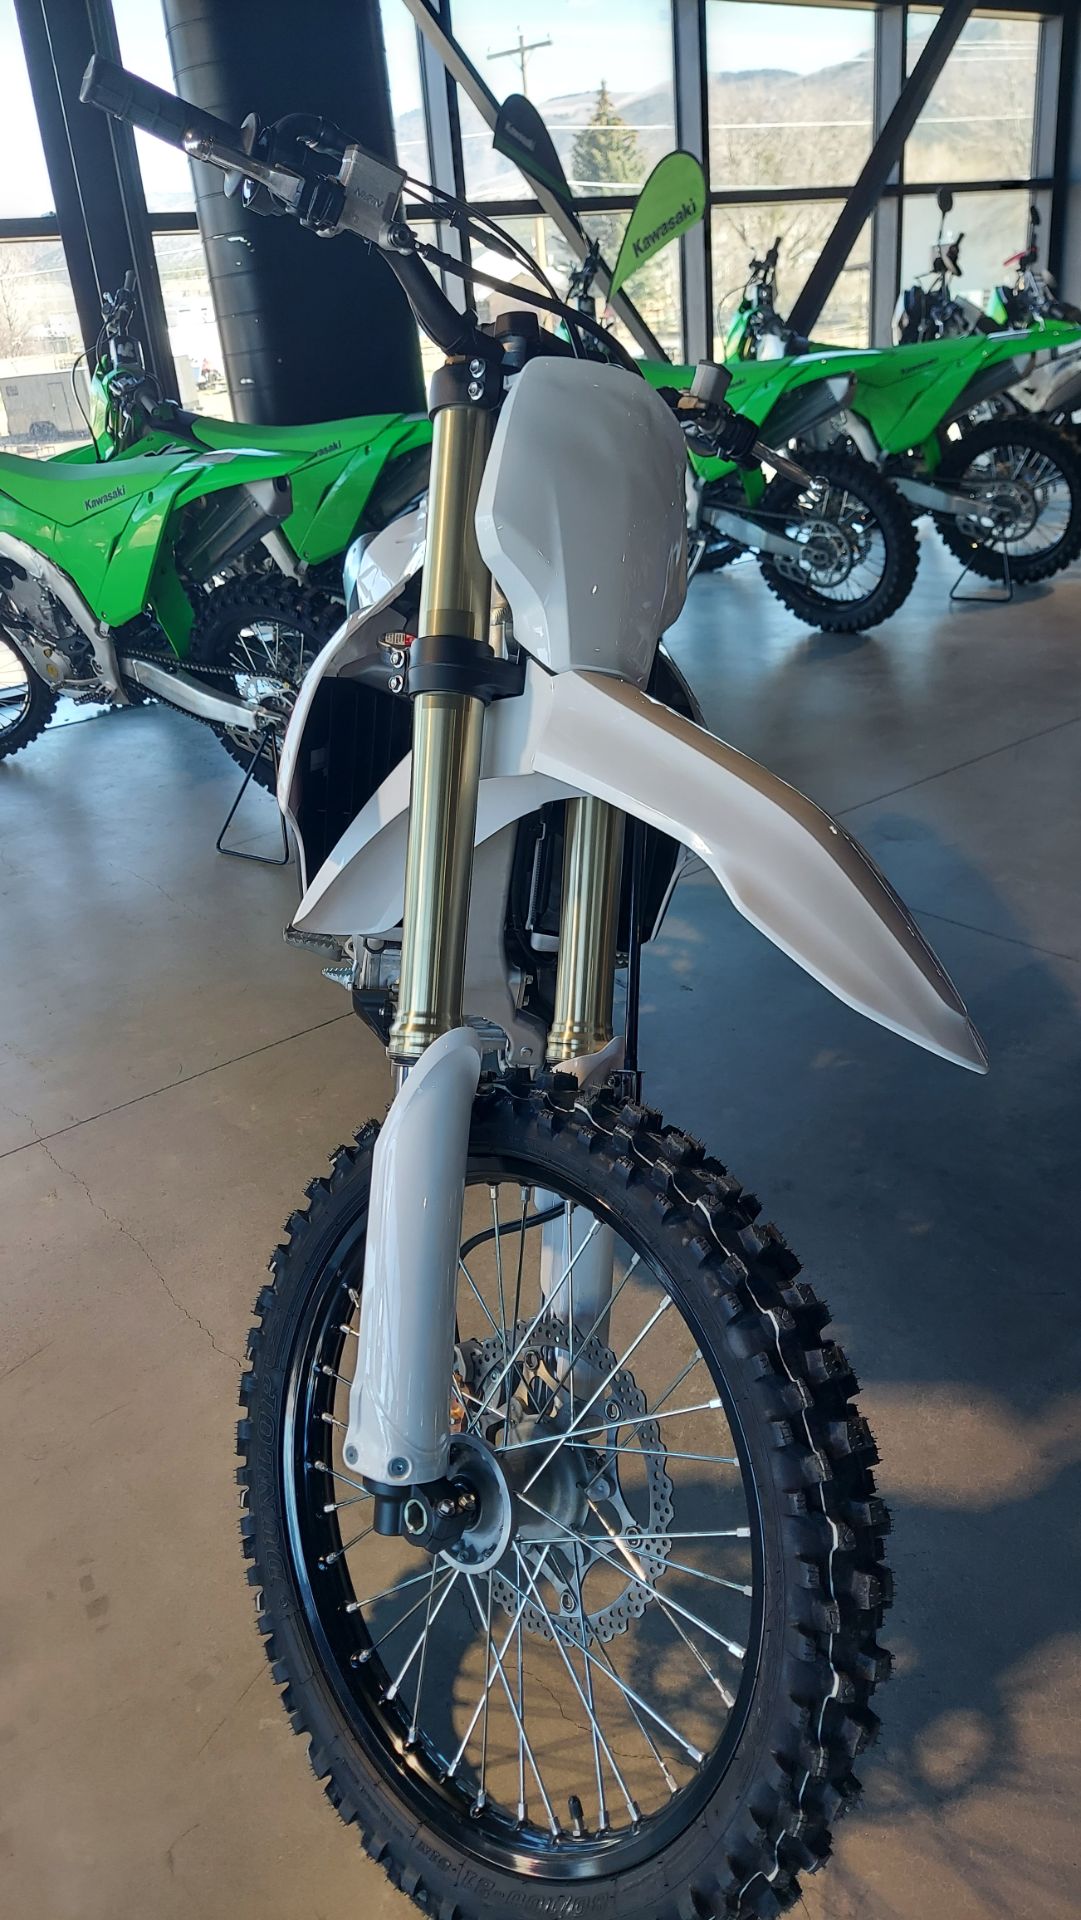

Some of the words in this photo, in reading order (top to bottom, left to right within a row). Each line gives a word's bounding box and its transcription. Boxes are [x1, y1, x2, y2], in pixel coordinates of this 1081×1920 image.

[632, 197, 697, 258] Kawasaki
[84, 484, 126, 511] Kawasaki
[256, 1373, 286, 1585] DUNLOP
